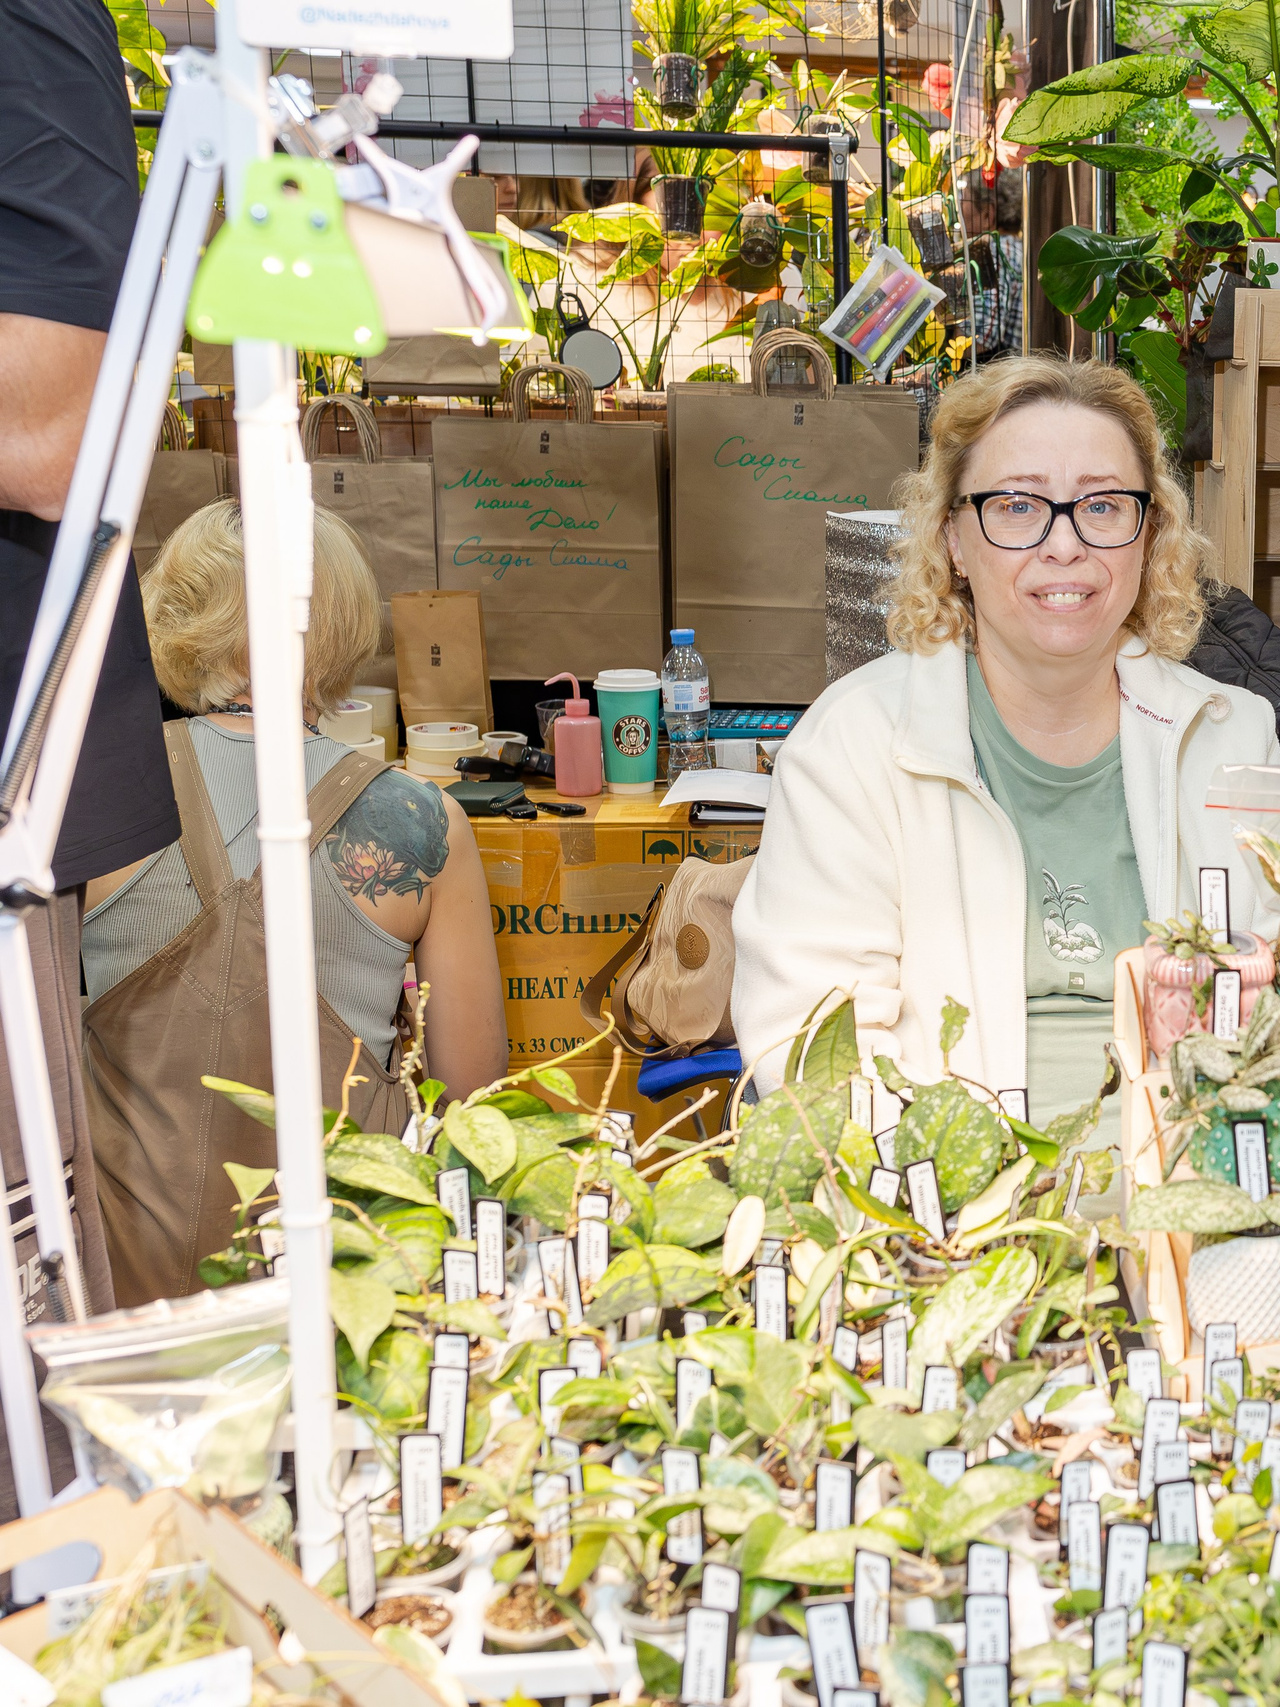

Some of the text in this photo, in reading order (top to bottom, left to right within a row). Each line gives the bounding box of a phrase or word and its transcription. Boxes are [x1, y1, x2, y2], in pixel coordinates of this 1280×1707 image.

[713, 435, 807, 482] Сады
[444, 469, 504, 490] Мы
[763, 475, 870, 509] Сиама
[474, 498, 533, 509] наше
[453, 536, 630, 580] Сады Сиама
[618, 715, 647, 729] STARS
[1136, 704, 1174, 725] NORTHLAND
[618, 744, 647, 756] COFFEE
[507, 976, 568, 1000] HEAT
[517, 1043, 526, 1053] x
[529, 1038, 546, 1053] 33
